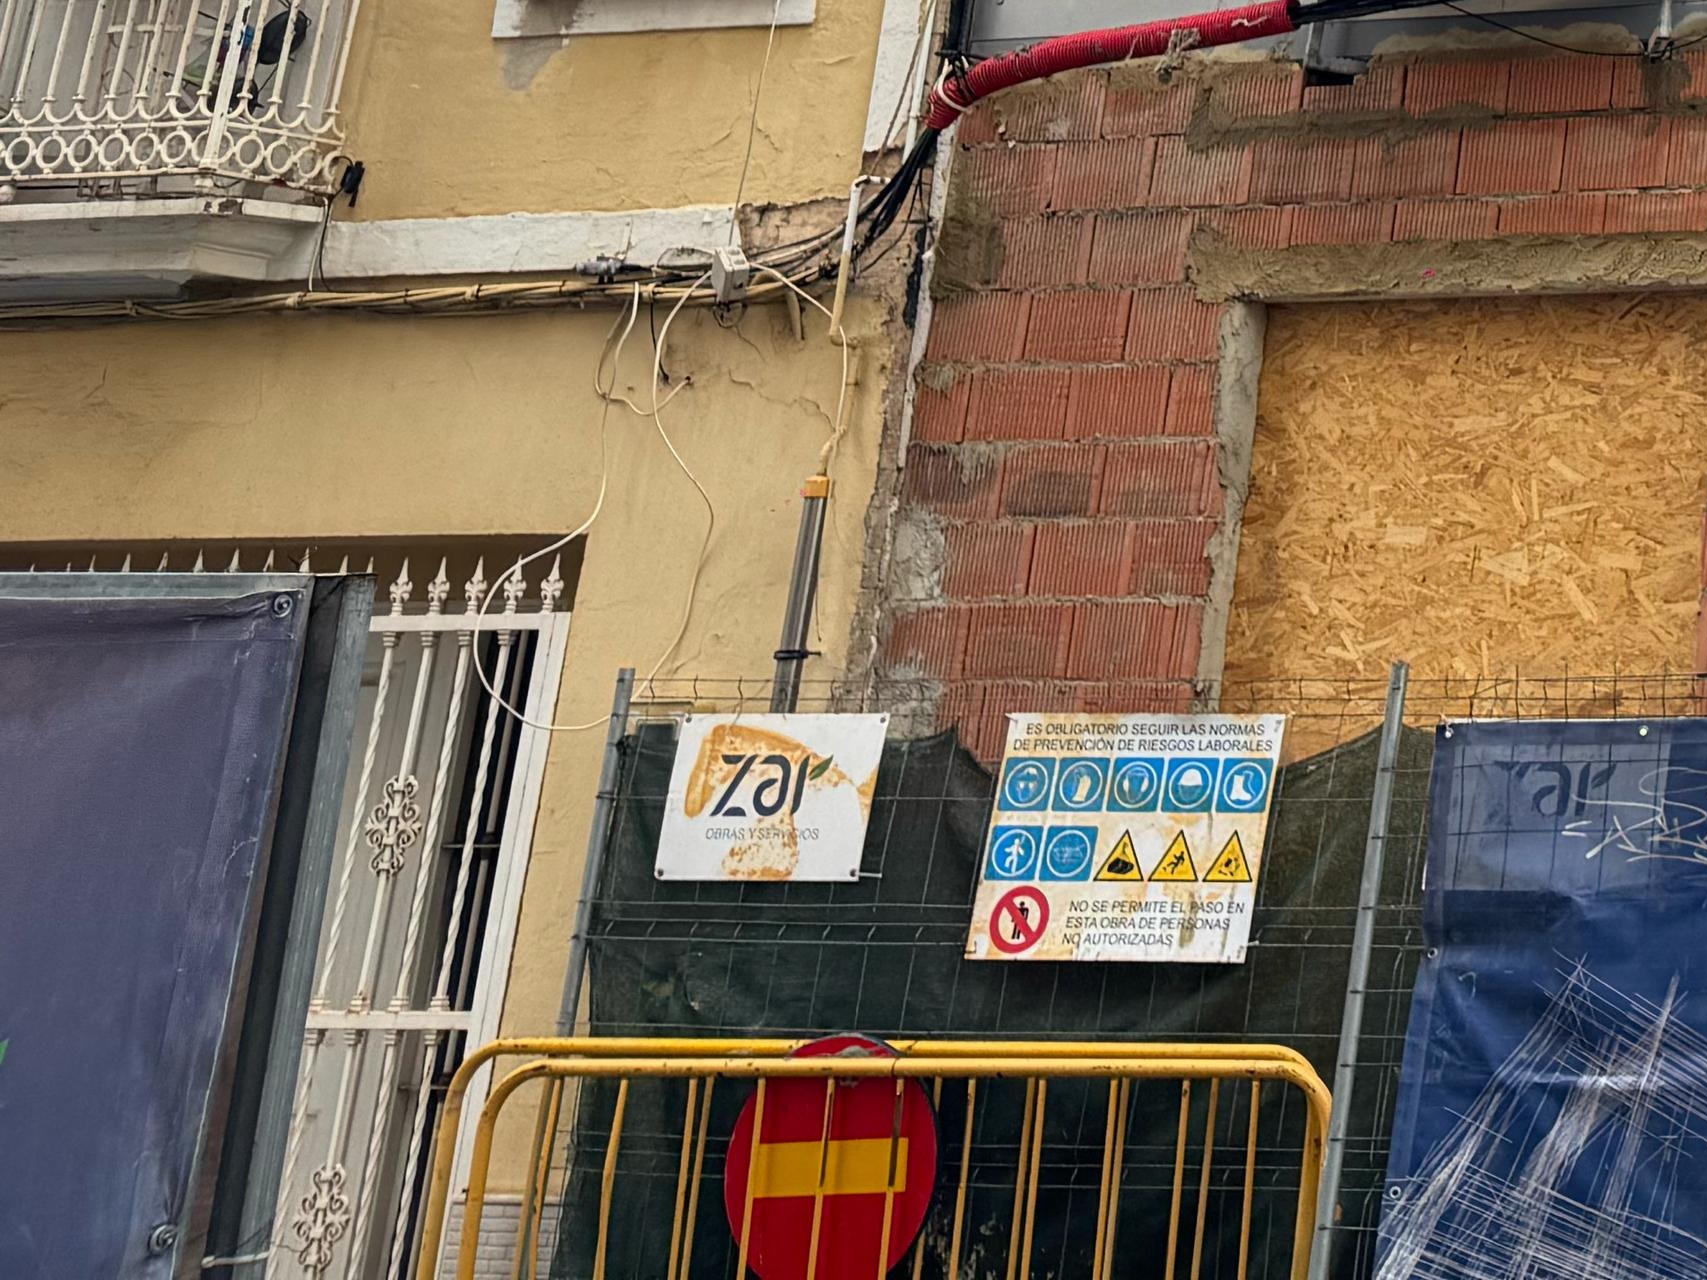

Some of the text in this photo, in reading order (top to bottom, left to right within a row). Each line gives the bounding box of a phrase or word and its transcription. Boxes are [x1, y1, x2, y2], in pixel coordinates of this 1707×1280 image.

[1026, 723, 1266, 736] ES OBLIGATORIO SEGUIR LAS NORMAS
[1013, 739, 1031, 751] DE
[1117, 739, 1136, 751] DE
[1138, 739, 1196, 751] RIESGOS
[1198, 739, 1273, 752] LABORALES
[705, 827, 745, 840] OBRAS
[748, 827, 757, 840] Y
[1069, 900, 1246, 914] NO SE PERMITE EL PASO EN
[1065, 916, 1231, 930] ESTA OBRA DE PERSONAS
[1061, 933, 1175, 946] NO AUTORIZADAS
